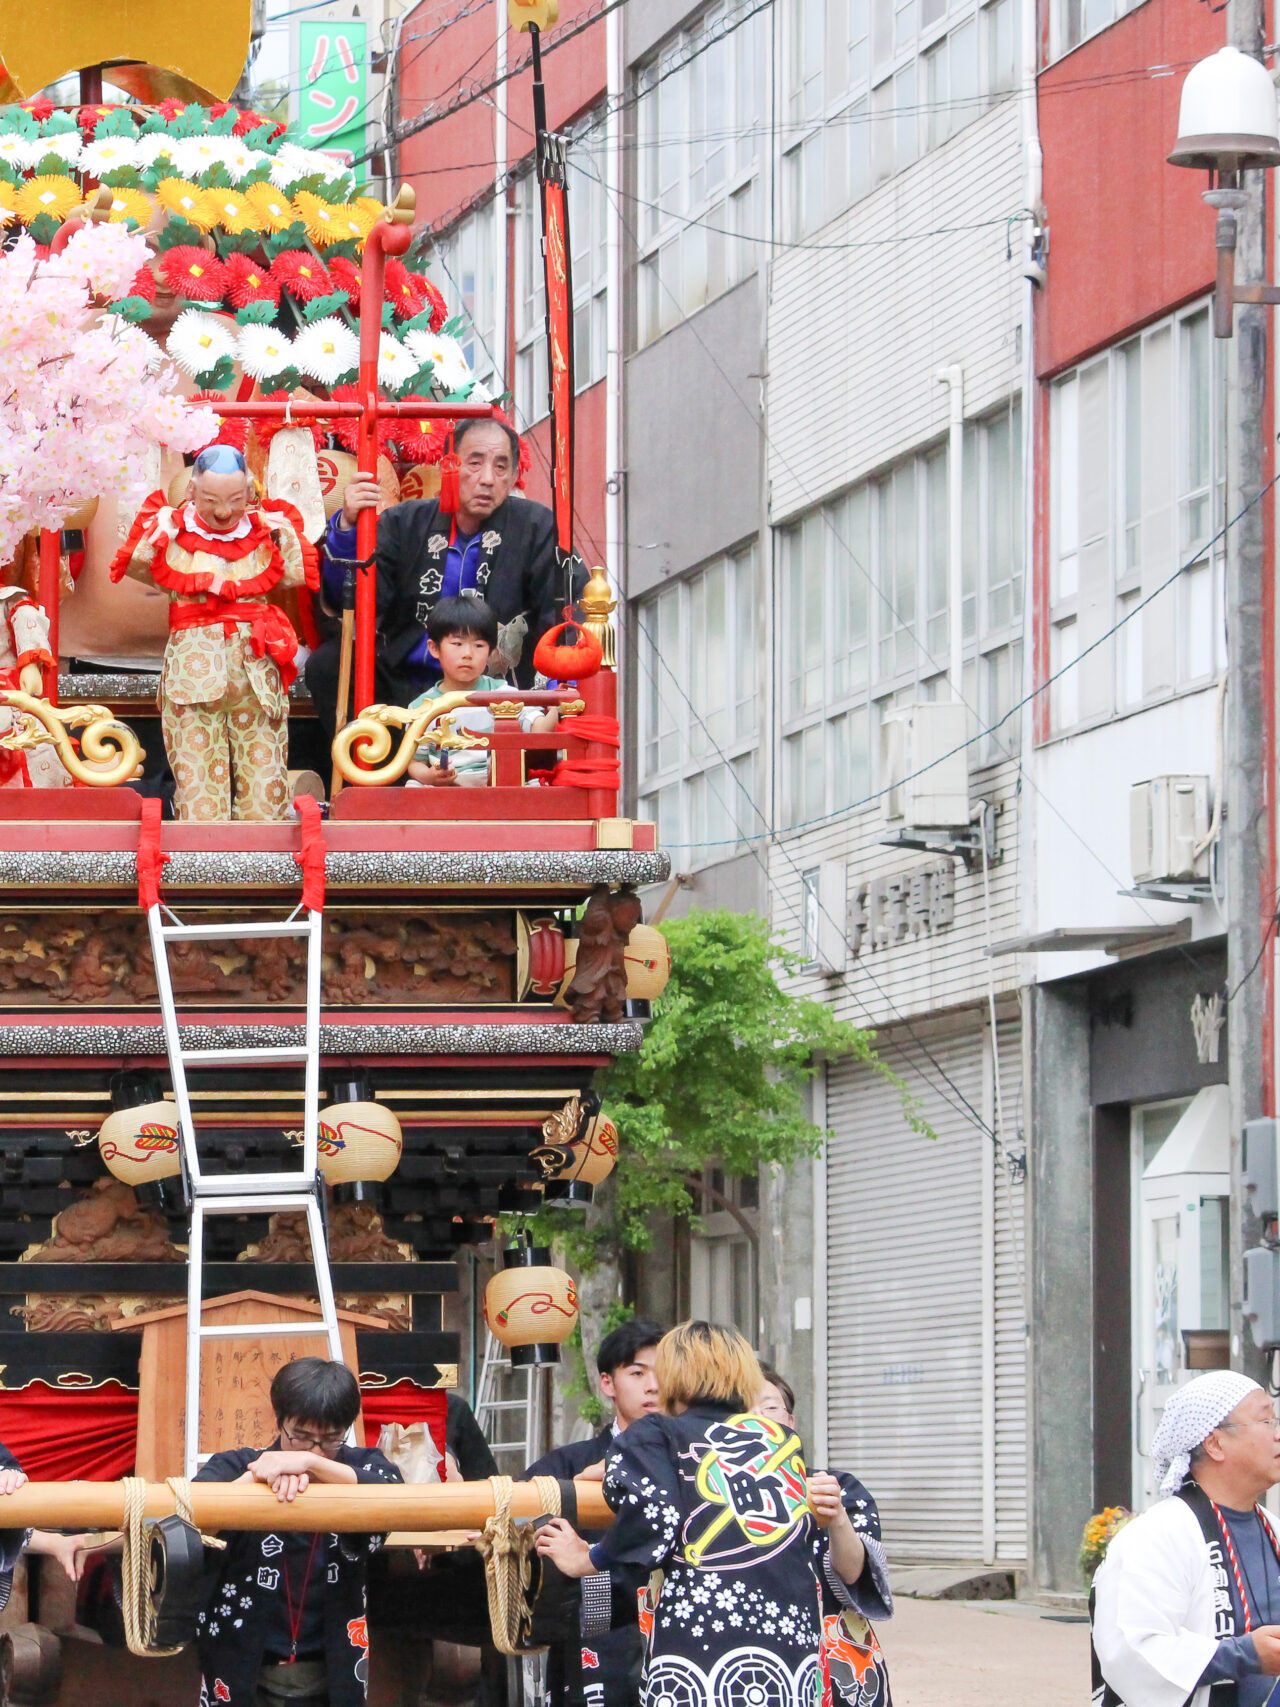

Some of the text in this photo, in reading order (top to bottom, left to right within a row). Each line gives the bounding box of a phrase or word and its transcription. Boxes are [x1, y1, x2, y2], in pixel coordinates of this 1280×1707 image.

[306, 34, 360, 170] ハン
[703, 1421, 796, 1529] 今町
[257, 1533, 284, 1591] 今町
